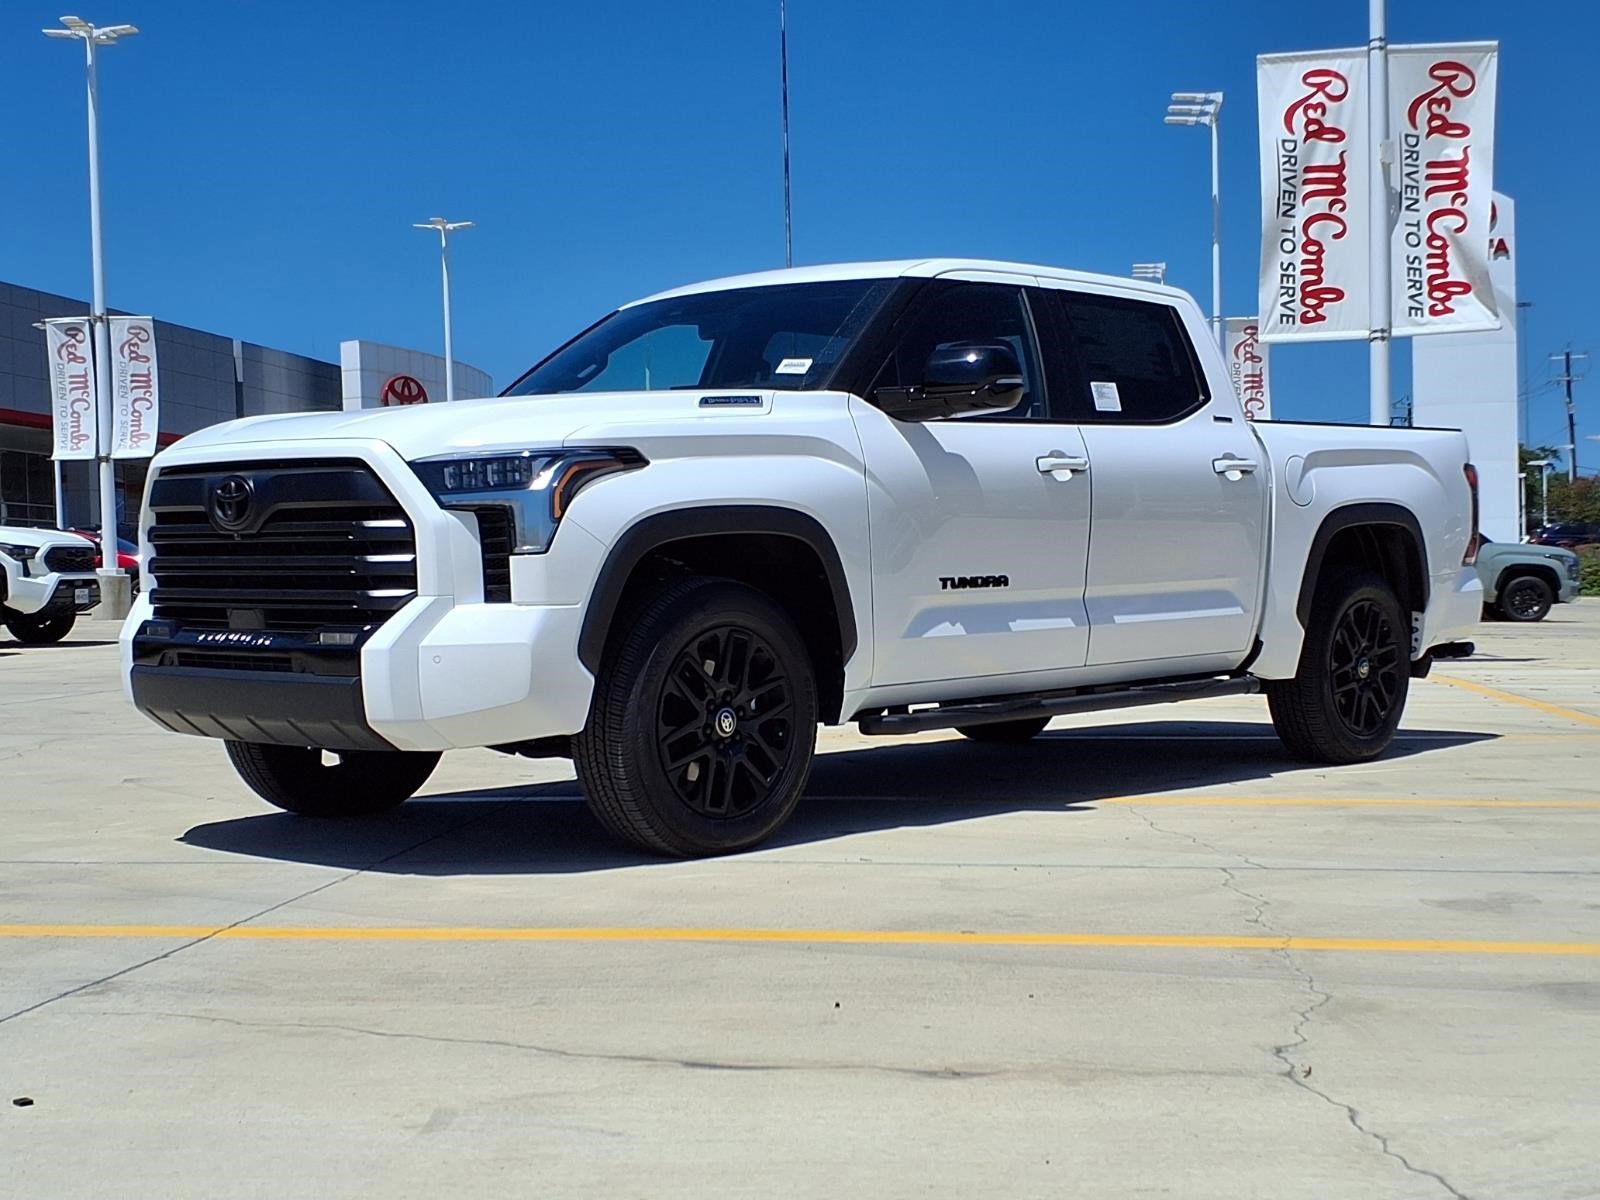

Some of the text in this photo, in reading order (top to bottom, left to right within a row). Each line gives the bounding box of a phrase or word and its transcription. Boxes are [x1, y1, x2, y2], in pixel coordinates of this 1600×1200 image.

[1279, 138, 1298, 326] DRIVEN TO SERVE
[1283, 68, 1349, 325] Red McCombs
[1403, 133, 1424, 318] DRIVEN TO SERVE
[1407, 61, 1476, 317] Red McCombs
[57, 326, 87, 365] Red
[119, 325, 150, 363] Red
[56, 363, 69, 450] DRIVEN TO SERVE
[118, 361, 129, 449] DRIVEN TO SERVE
[939, 575, 1010, 590] TUNDRA
